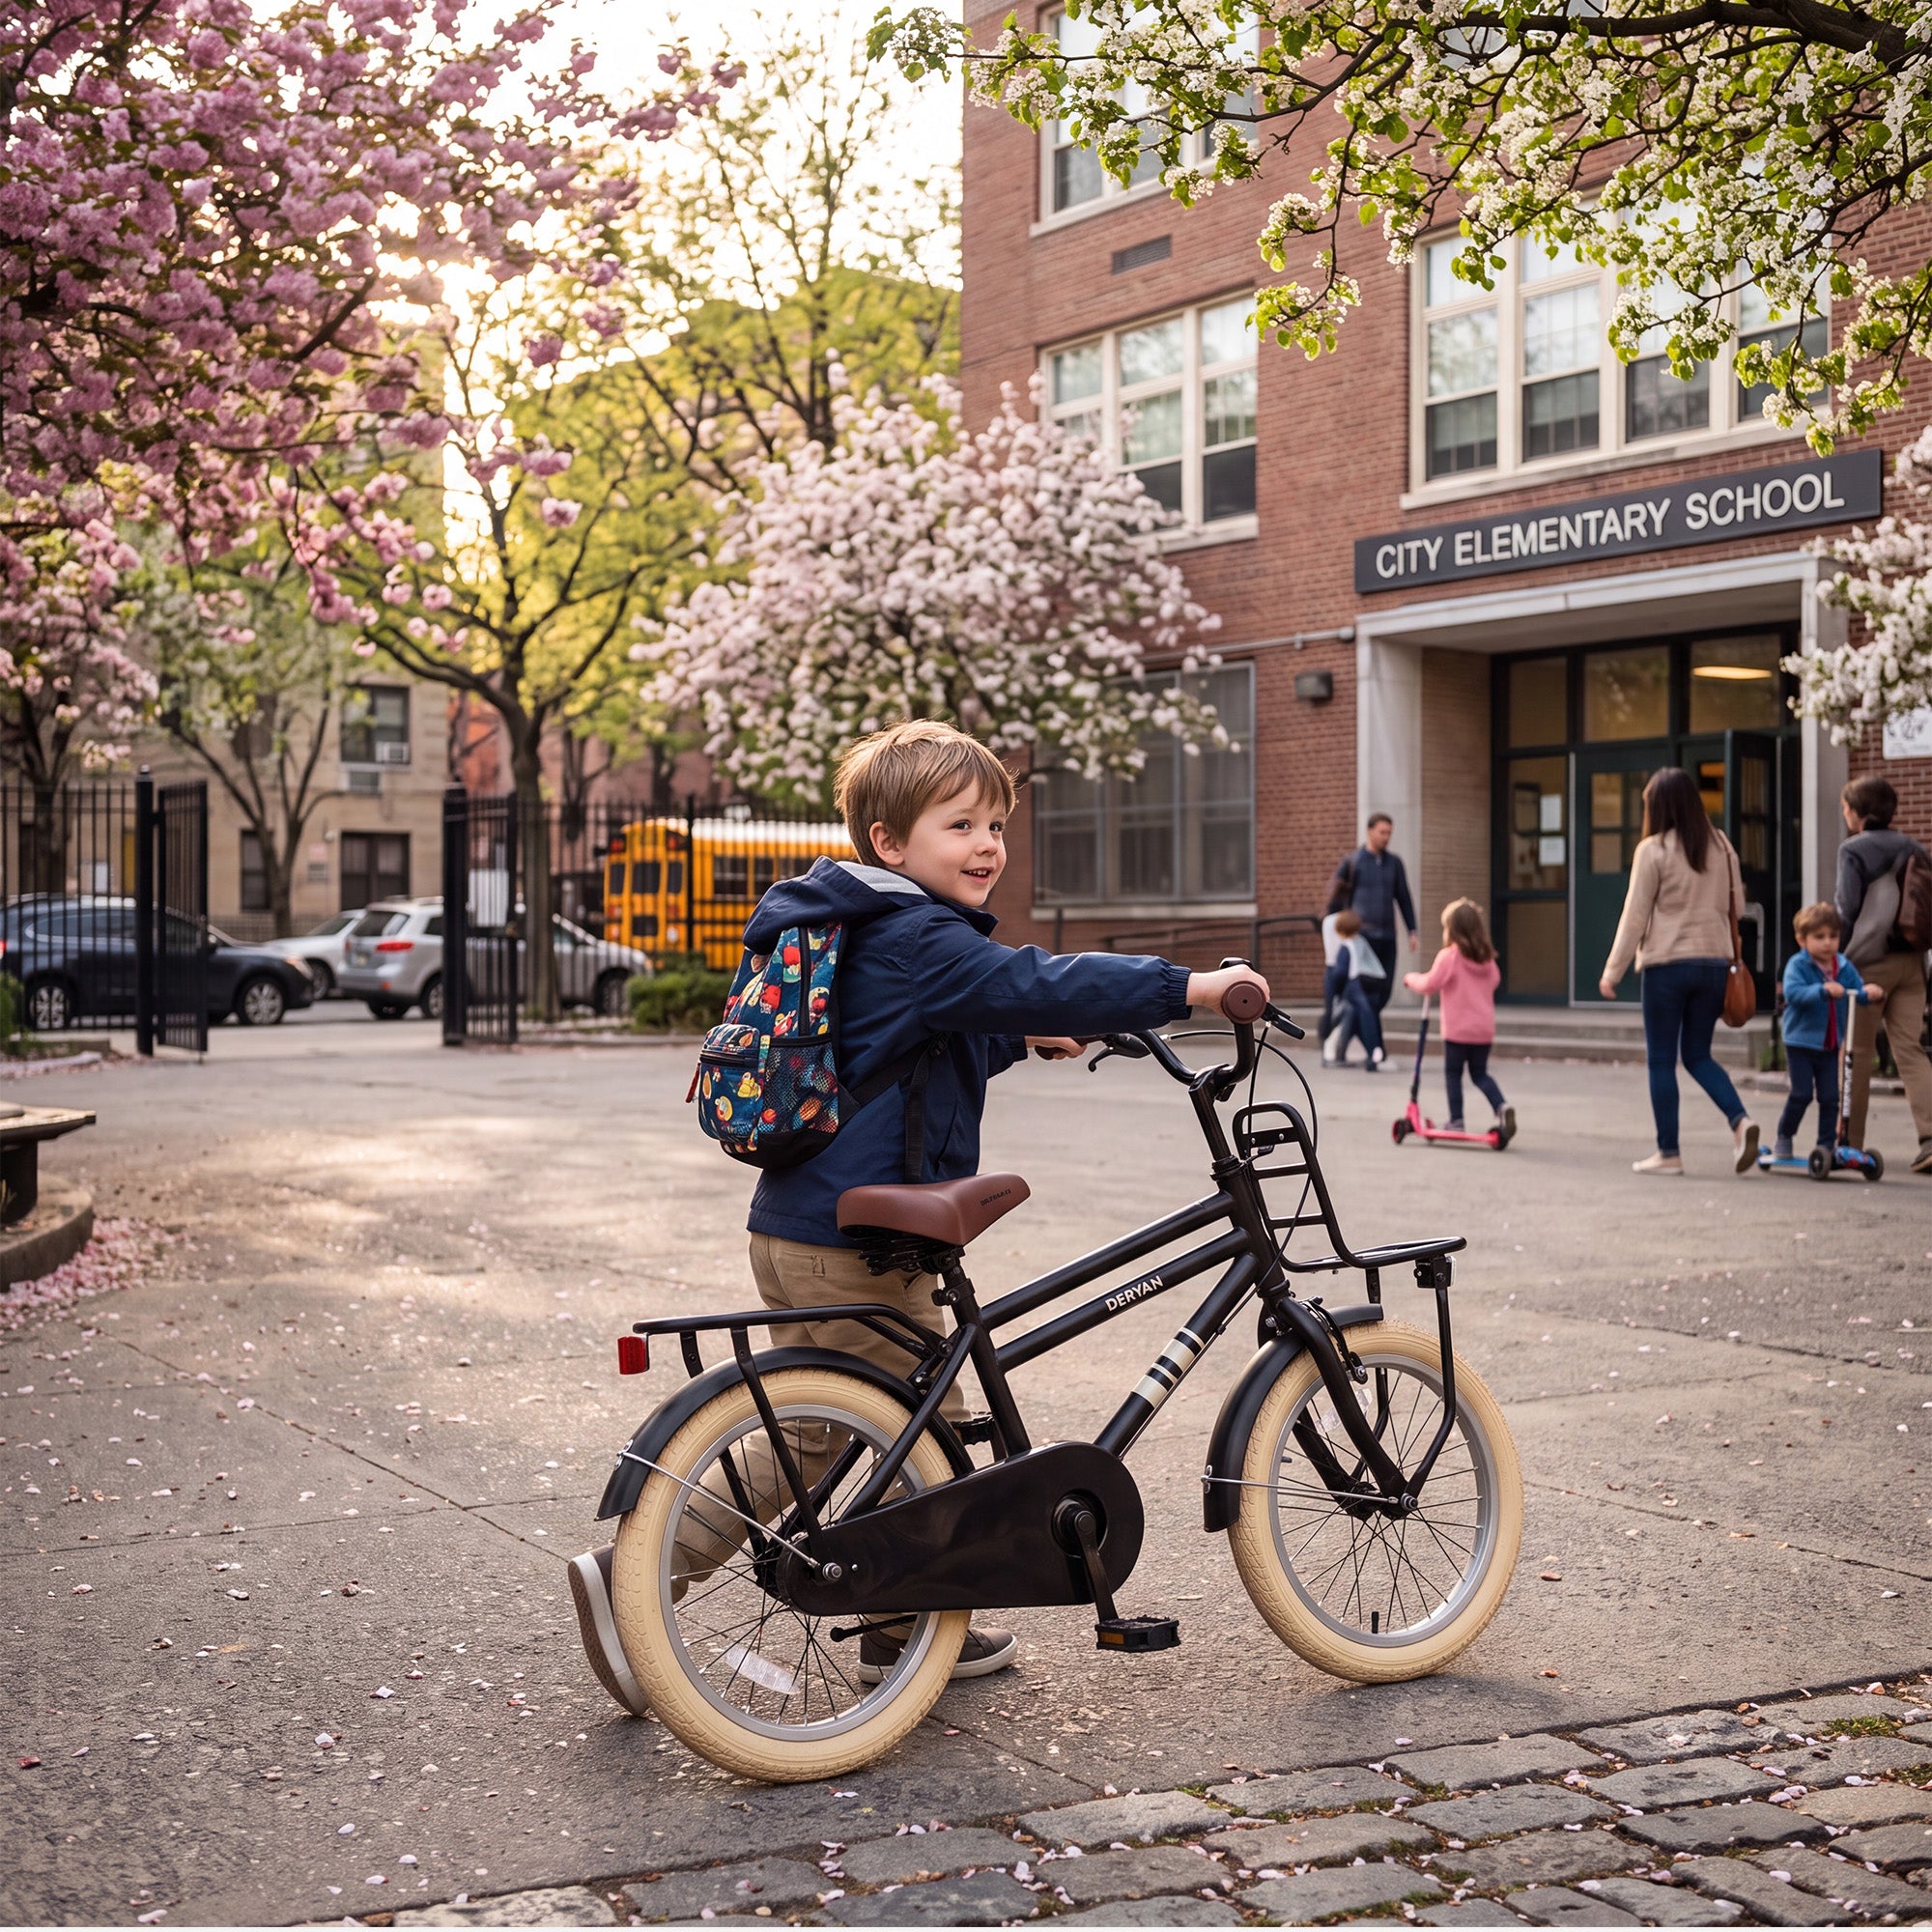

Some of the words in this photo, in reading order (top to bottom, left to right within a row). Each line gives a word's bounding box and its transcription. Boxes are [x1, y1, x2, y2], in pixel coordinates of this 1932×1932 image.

[1376, 537, 1443, 579] CITY
[1455, 497, 1671, 566] ELEMENTARY
[1685, 471, 1845, 530] SCHOOL
[1105, 1275, 1163, 1311] DERYAN
